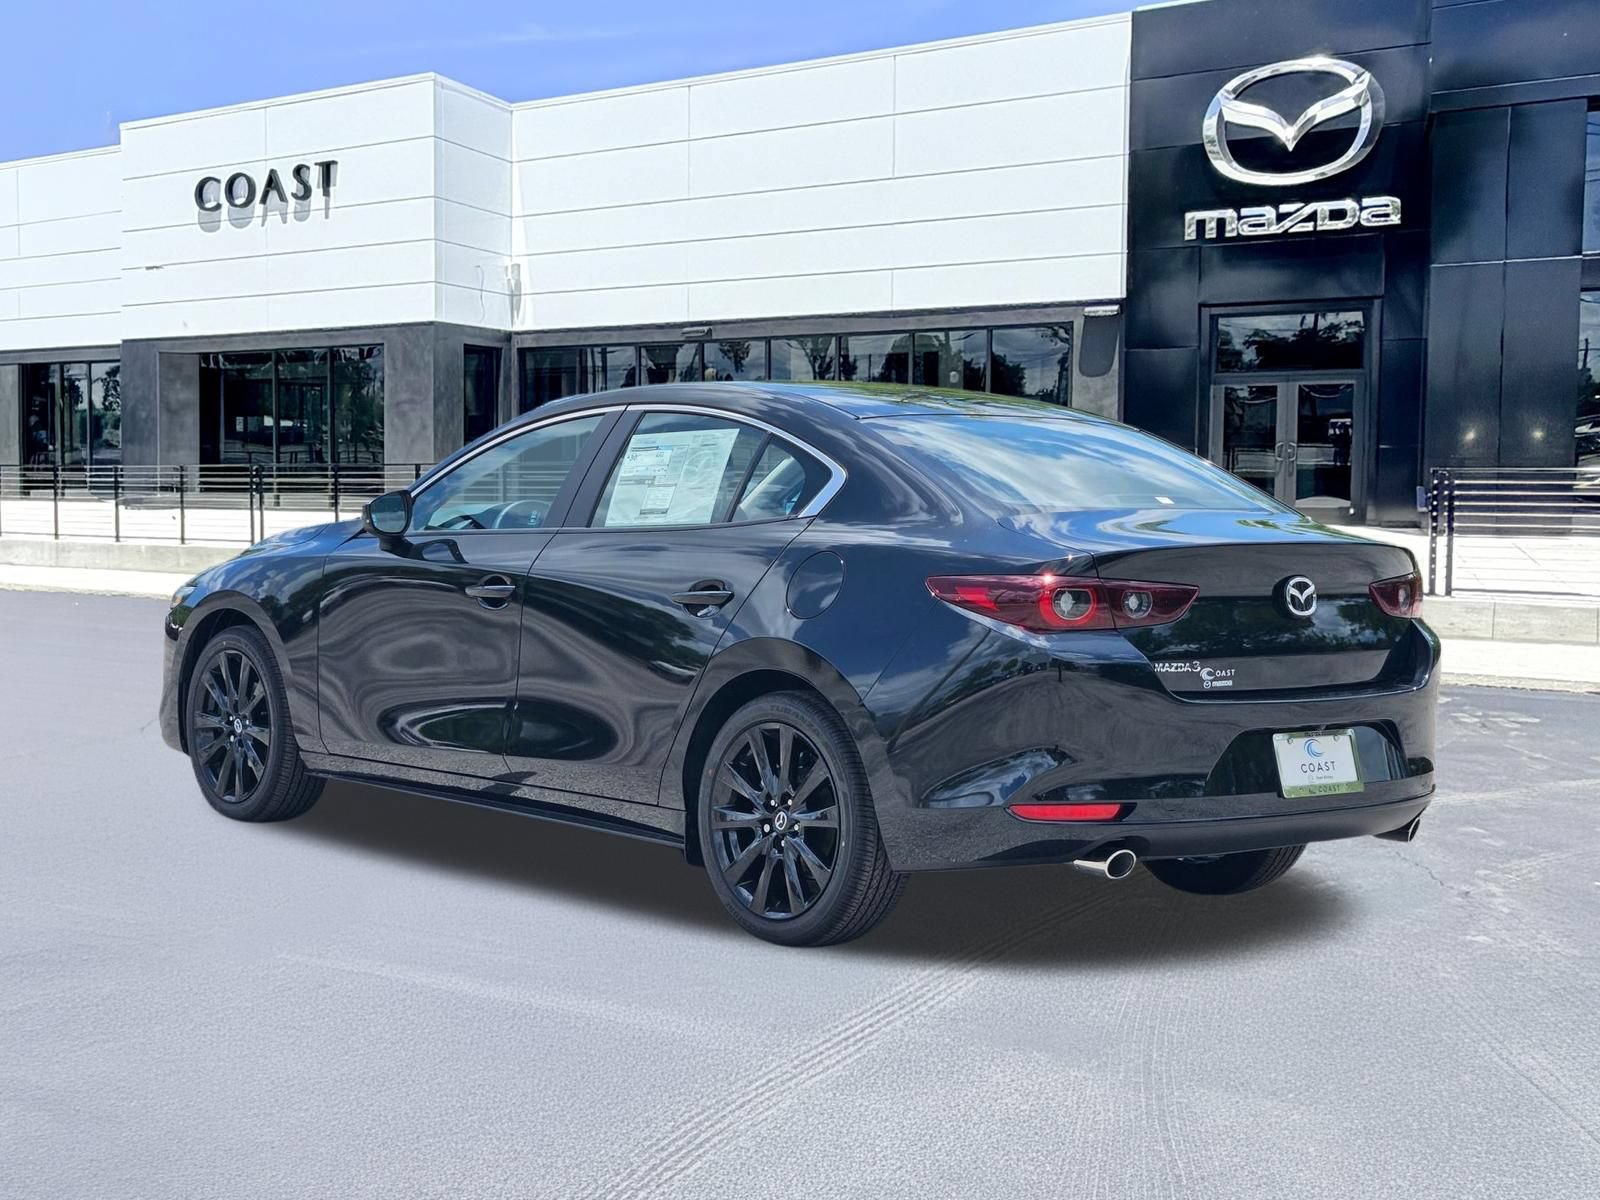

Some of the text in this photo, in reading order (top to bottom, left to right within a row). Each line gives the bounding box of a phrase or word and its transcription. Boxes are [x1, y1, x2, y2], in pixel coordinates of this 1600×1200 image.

[194, 159, 338, 212] COAST
[1184, 195, 1402, 241] mazda
[1154, 660, 1201, 673] MAZDA3
[1300, 760, 1336, 774] COAST
[1319, 784, 1340, 793] COAST
